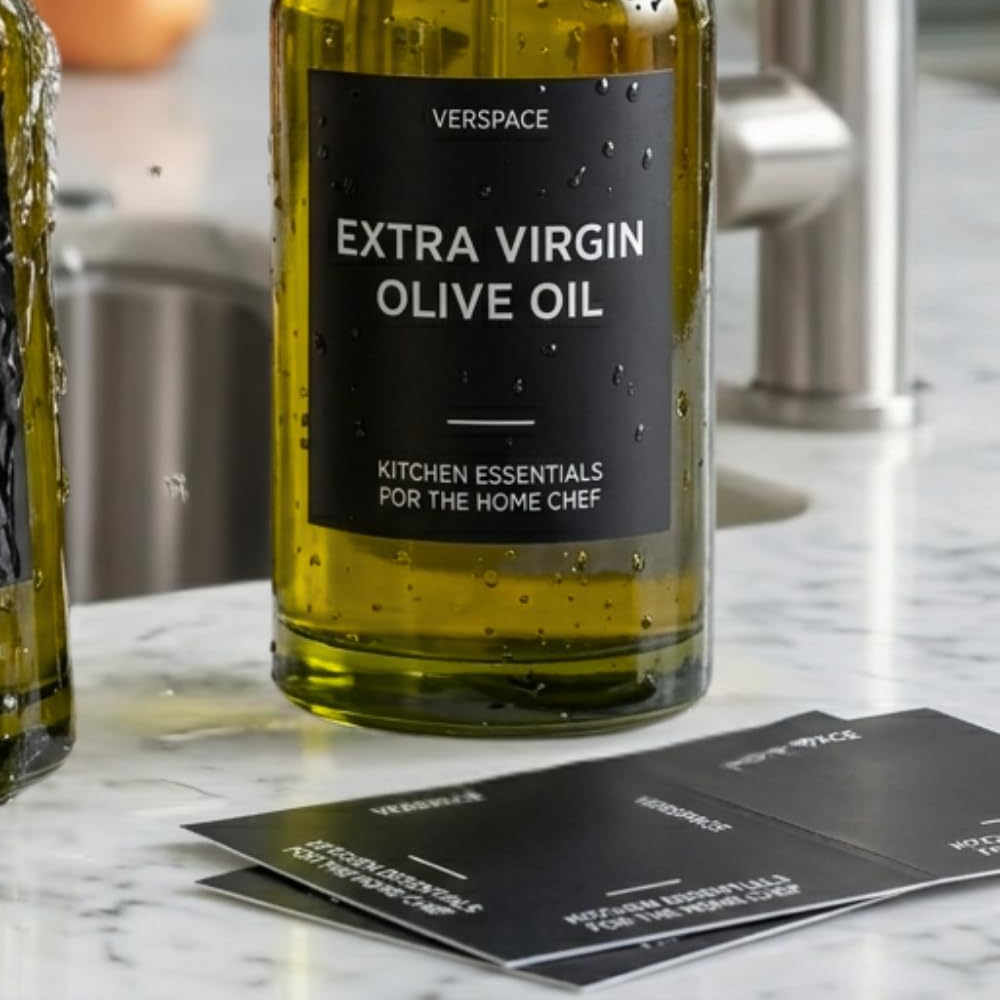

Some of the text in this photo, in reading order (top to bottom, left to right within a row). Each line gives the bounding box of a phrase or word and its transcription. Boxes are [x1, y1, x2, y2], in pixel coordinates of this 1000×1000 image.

[432, 109, 549, 130] VERSPACE
[337, 218, 644, 263] EXTRA VIRGIN
[377, 279, 604, 320] OLIVE OIL
[378, 460, 604, 486] KITCHEN ESSENTIALS
[428, 490, 469, 511] THE
[476, 492, 541, 512] HOME
[547, 487, 602, 510] CHEF
